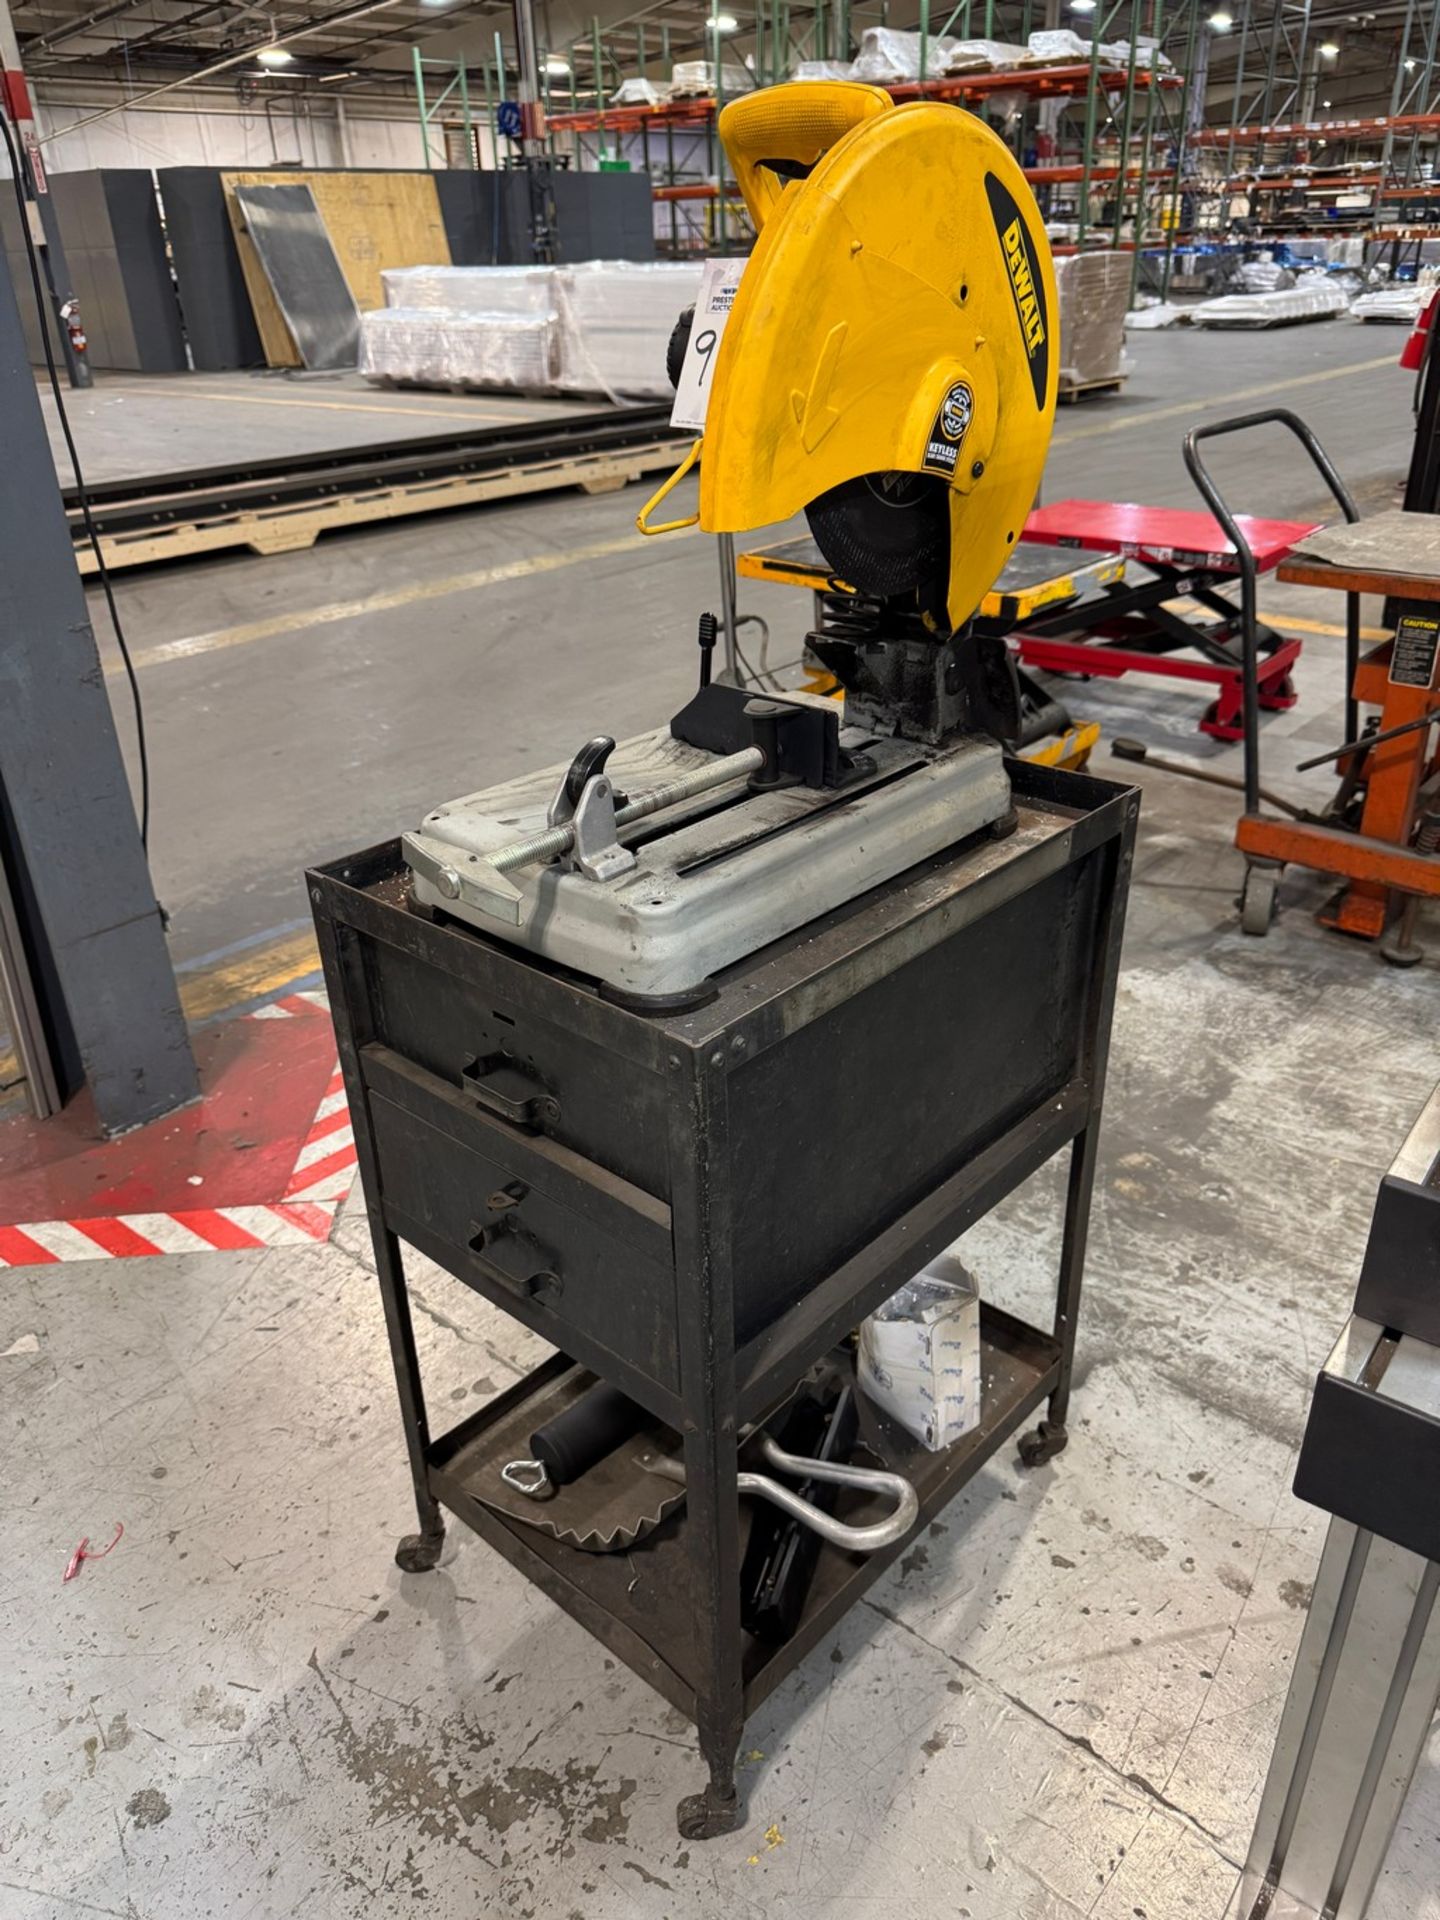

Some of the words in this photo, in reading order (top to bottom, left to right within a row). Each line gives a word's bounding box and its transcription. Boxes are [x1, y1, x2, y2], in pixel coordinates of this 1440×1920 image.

[1003, 219, 1043, 351] DEWALT
[695, 329, 717, 387] 9
[929, 442, 958, 458] KEYLESS
[1402, 618, 1438, 630] CAUTION
